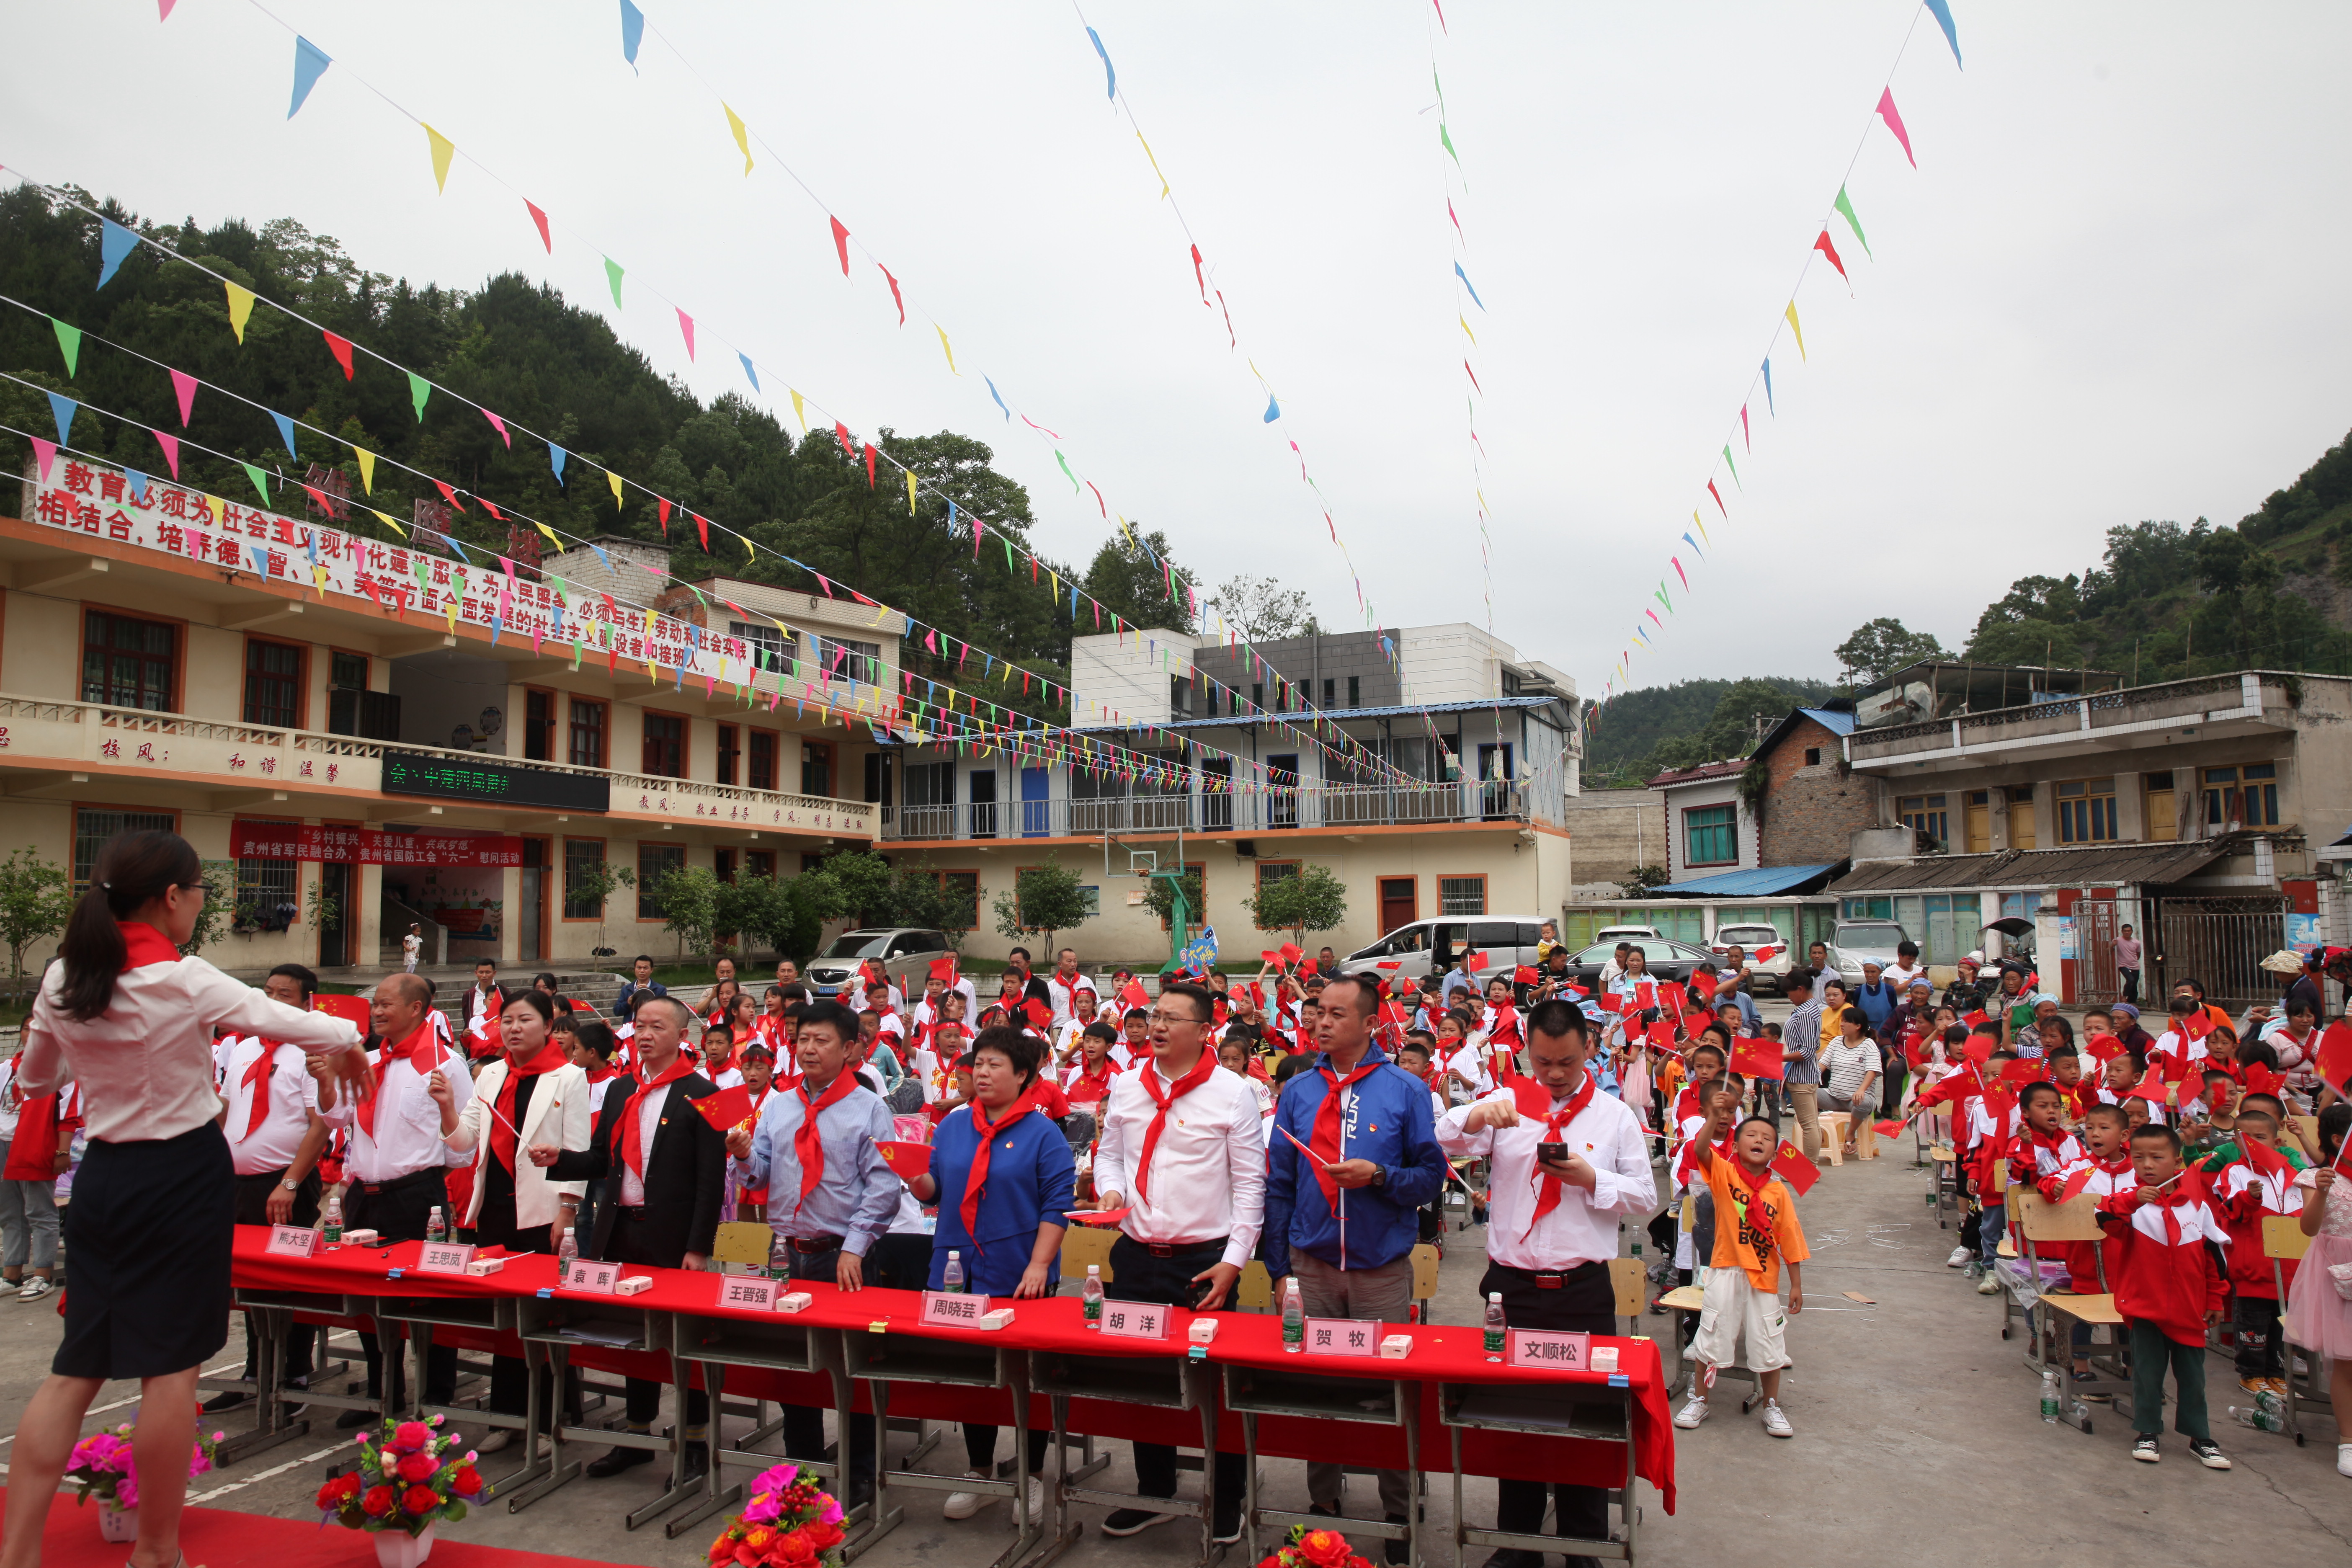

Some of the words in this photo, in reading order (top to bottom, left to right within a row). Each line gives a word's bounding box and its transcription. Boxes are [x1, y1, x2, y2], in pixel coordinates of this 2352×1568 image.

[229, 752, 340, 783] 和谐温馨
[696, 802, 749, 820] 敬业善导
[813, 814, 863, 830] 明志进取
[1189, 945, 1204, 967] 六一
[1347, 1093, 1361, 1139] RUN
[278, 1231, 310, 1248] 熊大坚
[428, 1251, 462, 1267] 王思岚
[573, 1269, 585, 1284] 袁
[729, 1286, 768, 1304] 王晋强
[933, 1300, 976, 1319] 周晓芸
[1109, 1313, 1125, 1330] 胡
[1139, 1315, 1155, 1332] 洋
[1316, 1329, 1332, 1347] 贺
[1348, 1331, 1366, 1348] 牧
[1524, 1341, 1577, 1362] 文顺松
